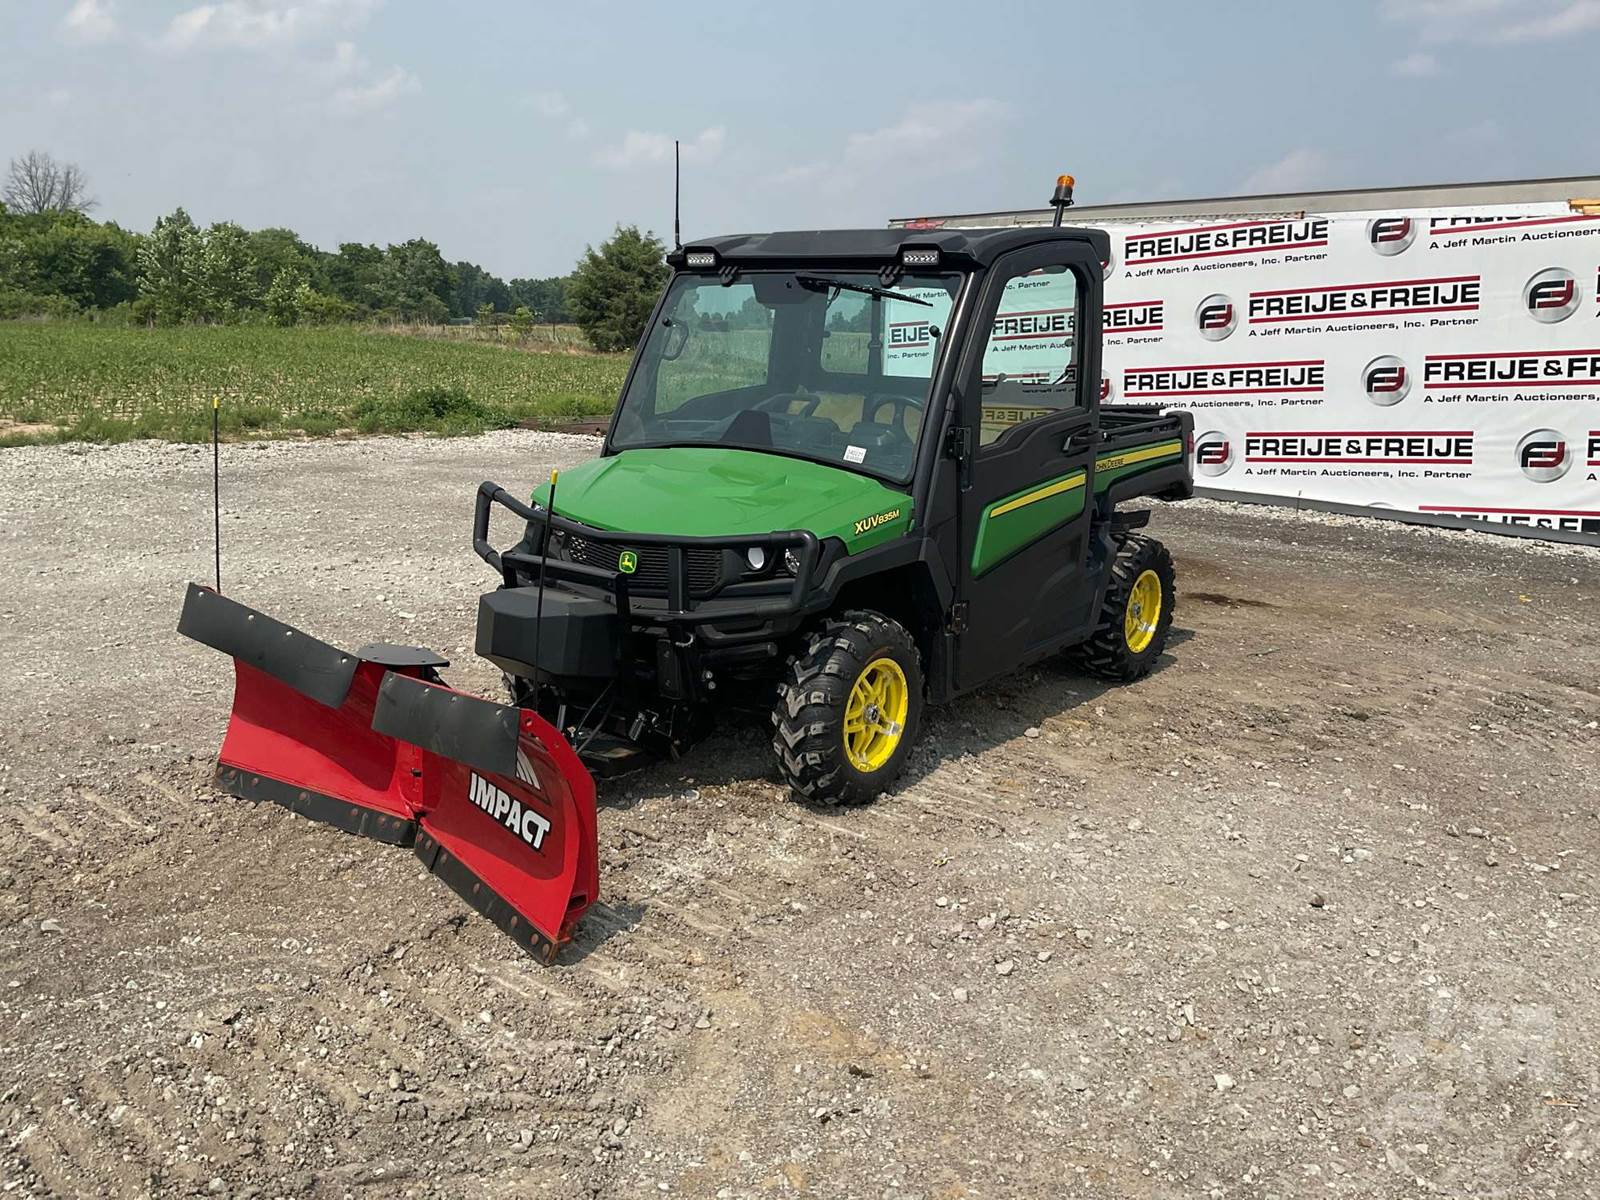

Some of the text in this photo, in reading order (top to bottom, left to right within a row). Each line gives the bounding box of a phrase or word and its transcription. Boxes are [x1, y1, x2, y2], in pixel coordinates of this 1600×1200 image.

[1429, 241, 1440, 250] A
[1443, 238, 1468, 249] Jeff
[1471, 234, 1517, 246] Martin
[1135, 268, 1154, 278] Jeff
[1156, 266, 1190, 275] Martin
[1192, 260, 1258, 272] Auctioneers,
[1261, 257, 1281, 265] Inc.
[1284, 253, 1328, 263] Partner
[1017, 280, 1051, 289] Partner
[922, 291, 948, 299] Martin
[1248, 318, 1479, 337] A Jeff Martin Auctioneers, Inc. Partner
[1107, 338, 1124, 346] Inc.
[992, 345, 999, 353] A
[1001, 344, 1017, 352] Jeff
[1189, 400, 1254, 408] Auctioneers,
[1280, 398, 1324, 406] Partner
[1423, 392, 1600, 403] A Jeff Martin Auctioneers,
[1256, 468, 1277, 476] Jeff
[1280, 468, 1317, 476] Martin
[1320, 468, 1394, 479] Auctioneers,
[1398, 469, 1419, 478] Inc.
[1423, 470, 1472, 479] Partner
[469, 772, 551, 849] IMPACT
